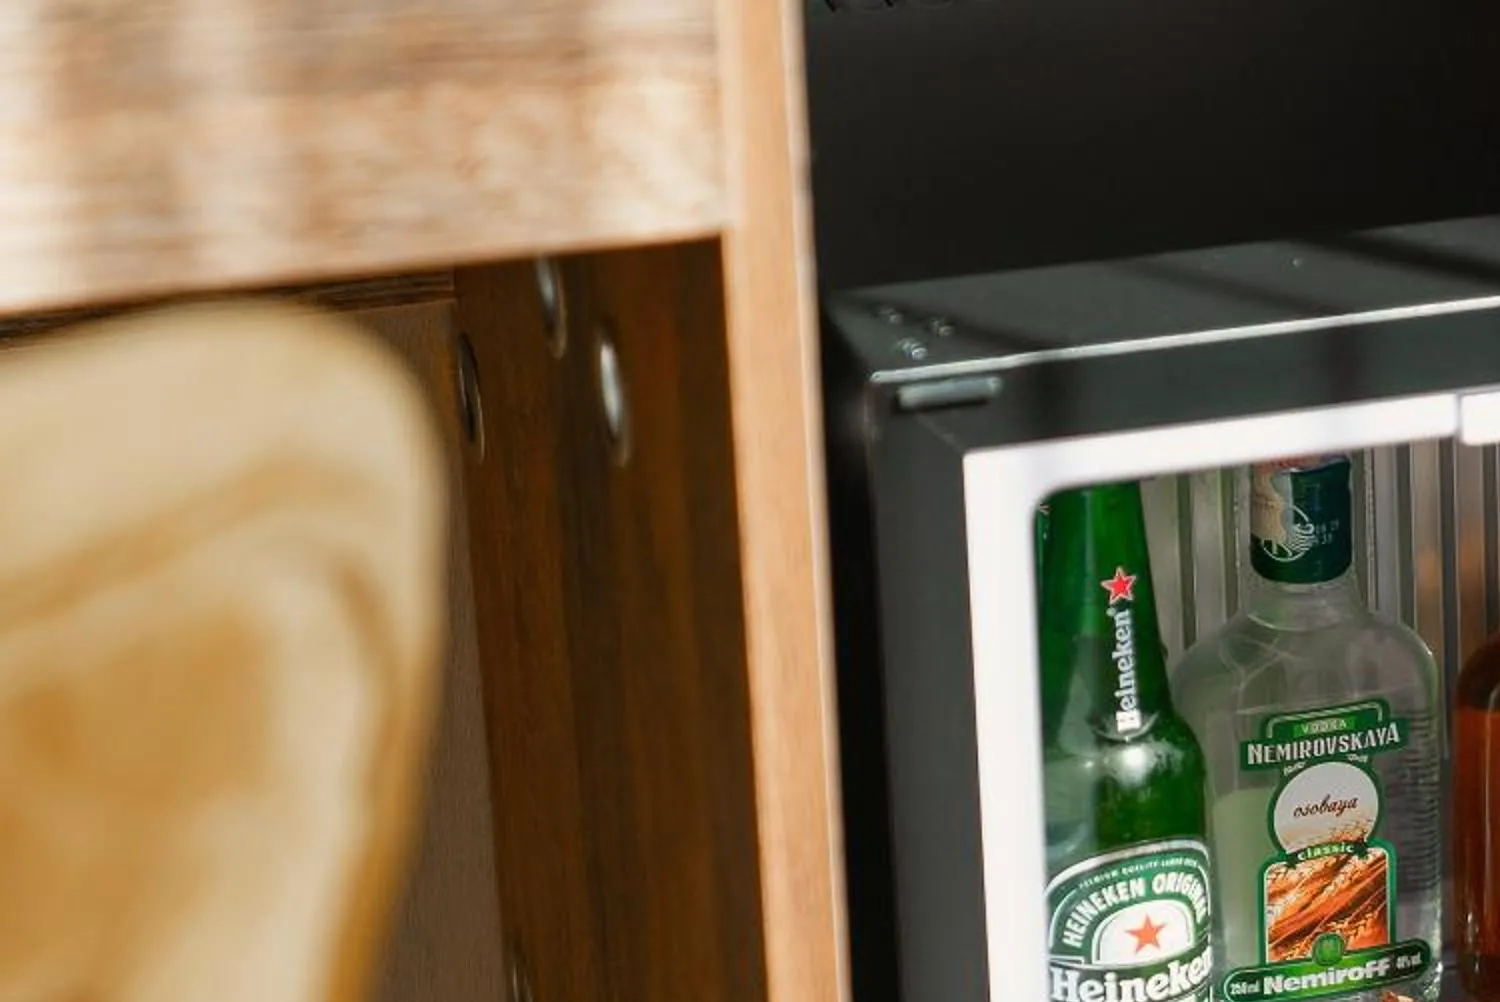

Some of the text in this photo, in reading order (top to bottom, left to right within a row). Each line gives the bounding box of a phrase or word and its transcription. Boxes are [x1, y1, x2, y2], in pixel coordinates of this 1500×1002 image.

[1111, 607, 1143, 734] Heineken
[1247, 722, 1401, 765] NEMIROVSKAYA
[1293, 794, 1359, 817] osobaya
[1297, 842, 1355, 861] classic
[1062, 876, 1147, 948] HEINEKEN
[1262, 957, 1392, 995] Nemiroff
